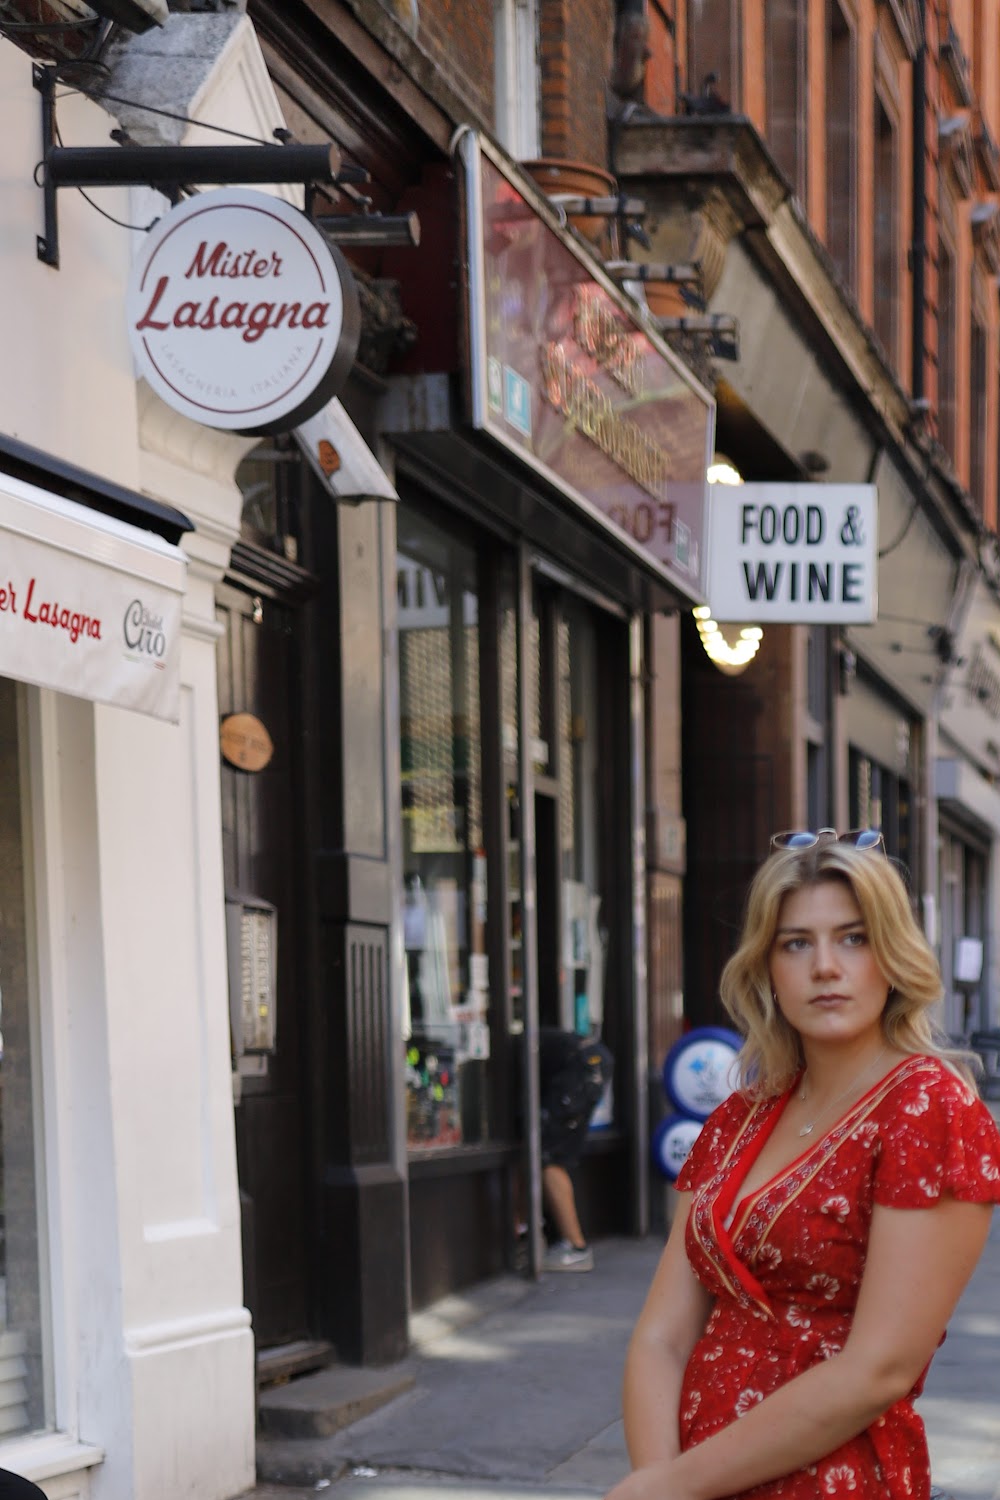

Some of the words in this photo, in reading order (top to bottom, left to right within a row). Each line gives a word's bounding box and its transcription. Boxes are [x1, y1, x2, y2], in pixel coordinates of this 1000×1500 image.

[184, 241, 282, 279] Mister
[136, 276, 330, 343] Lasagna
[250, 345, 304, 396] ITALIANA
[742, 505, 823, 545] FOOD
[840, 505, 864, 546] &
[742, 562, 864, 603] WINE
[24, 578, 102, 644] Lasagna
[123, 599, 166, 657] Ciro
